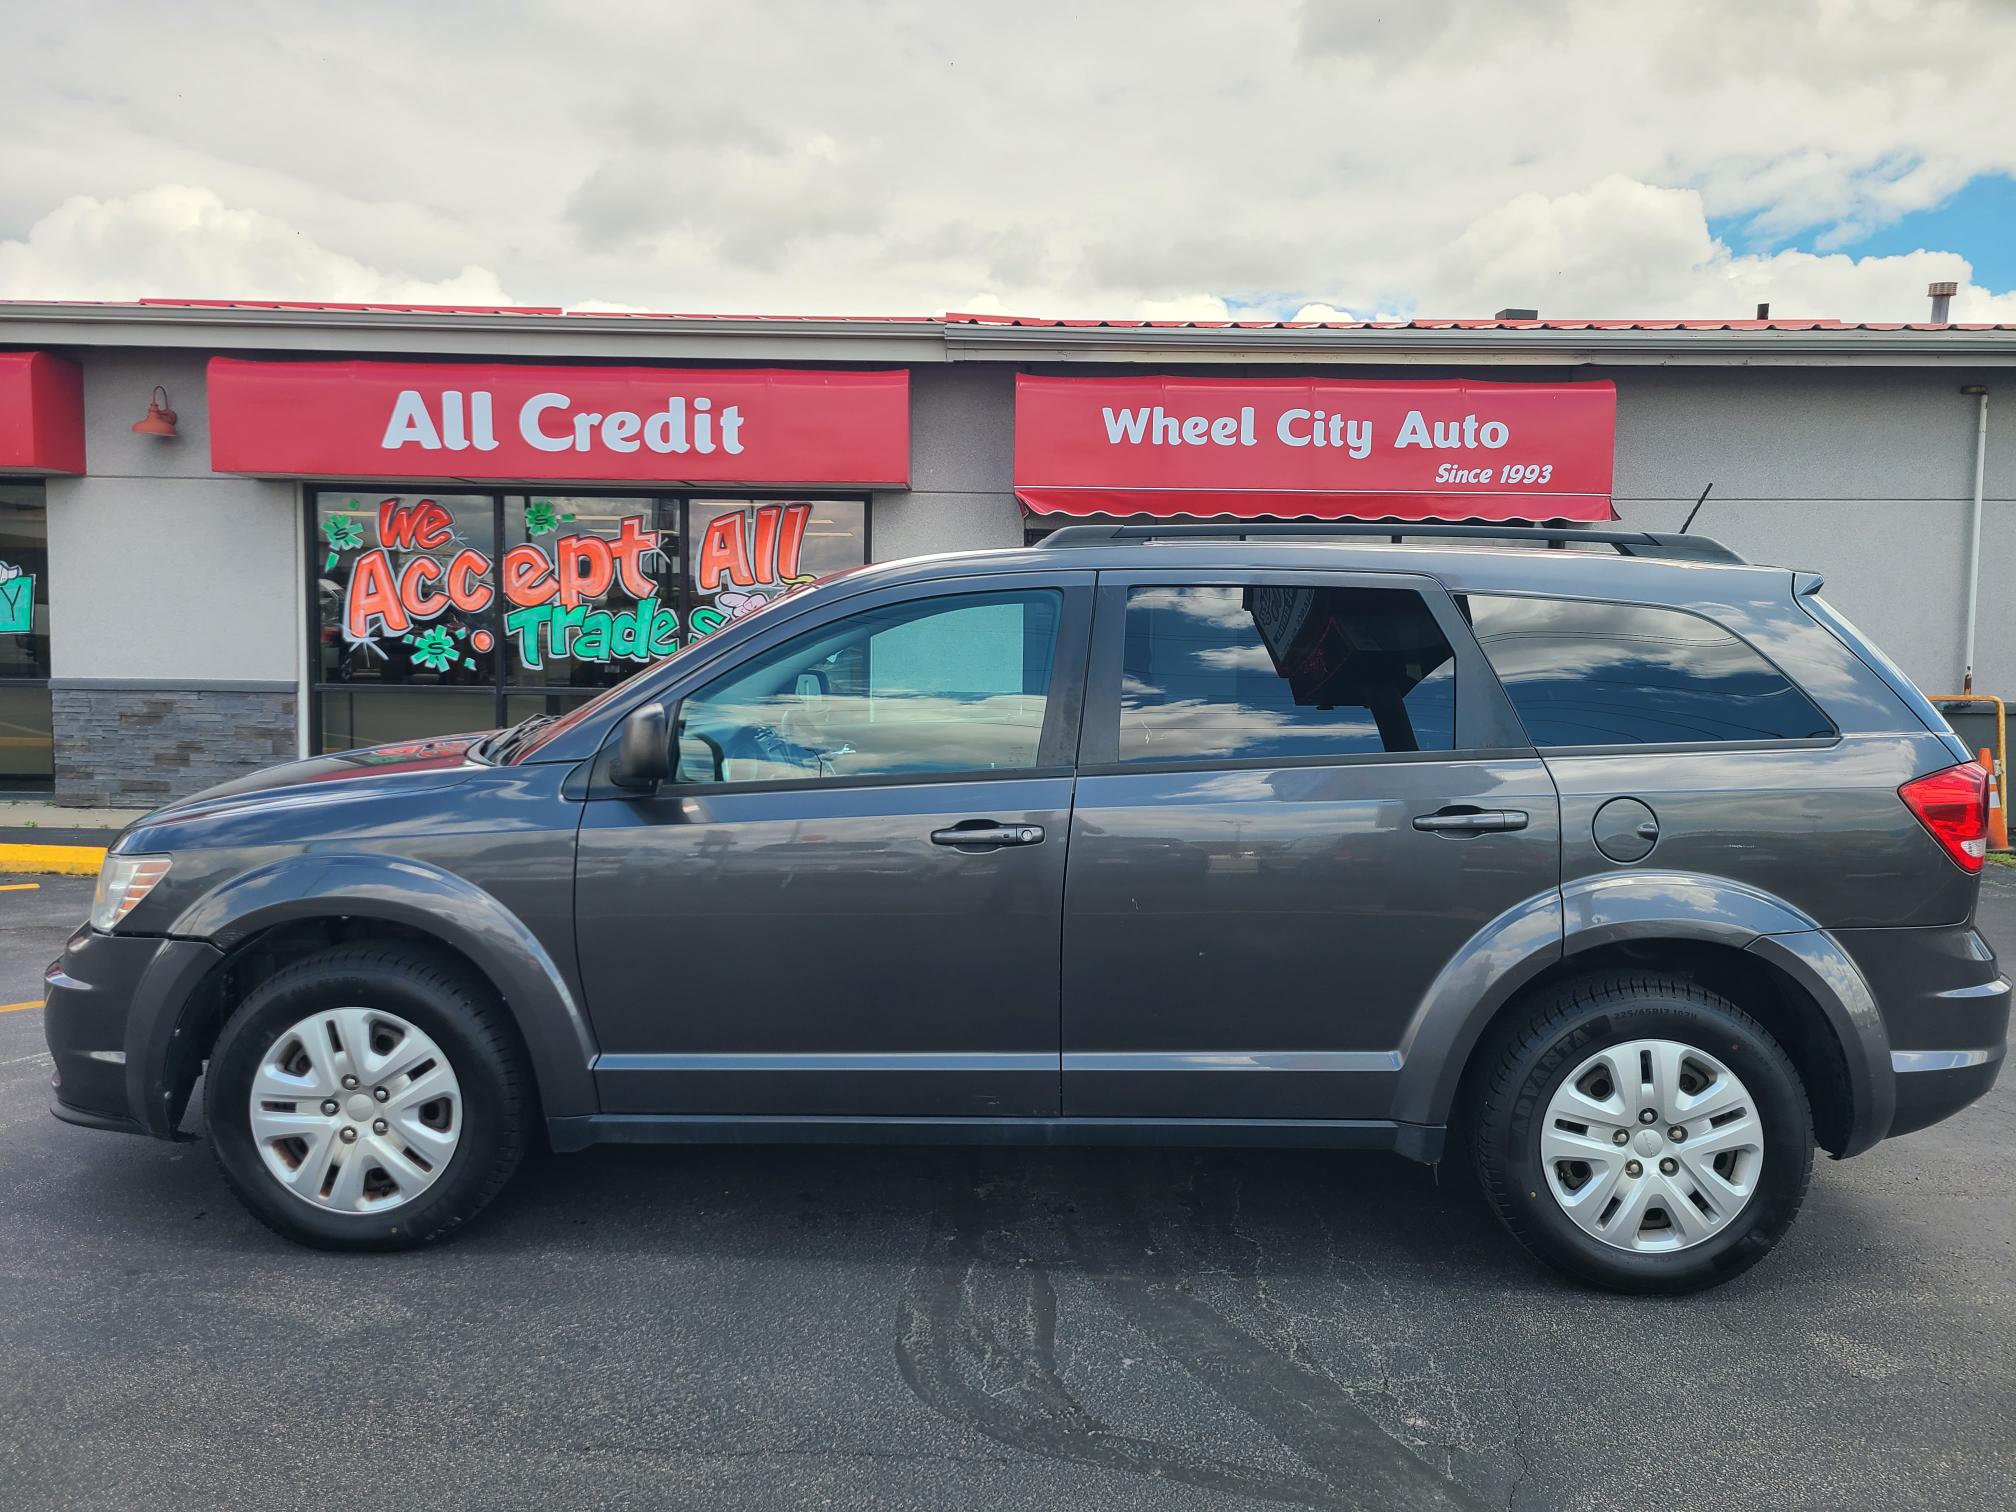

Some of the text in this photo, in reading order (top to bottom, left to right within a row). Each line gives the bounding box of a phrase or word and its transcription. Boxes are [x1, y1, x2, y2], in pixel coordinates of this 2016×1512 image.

[381, 390, 745, 455] All Credit
[1102, 406, 1510, 460] Wheel City Auto
[1435, 463, 1553, 485] Since 1993
[378, 498, 455, 550] We
[344, 502, 812, 641] Accept All
[506, 597, 729, 670] Trades
